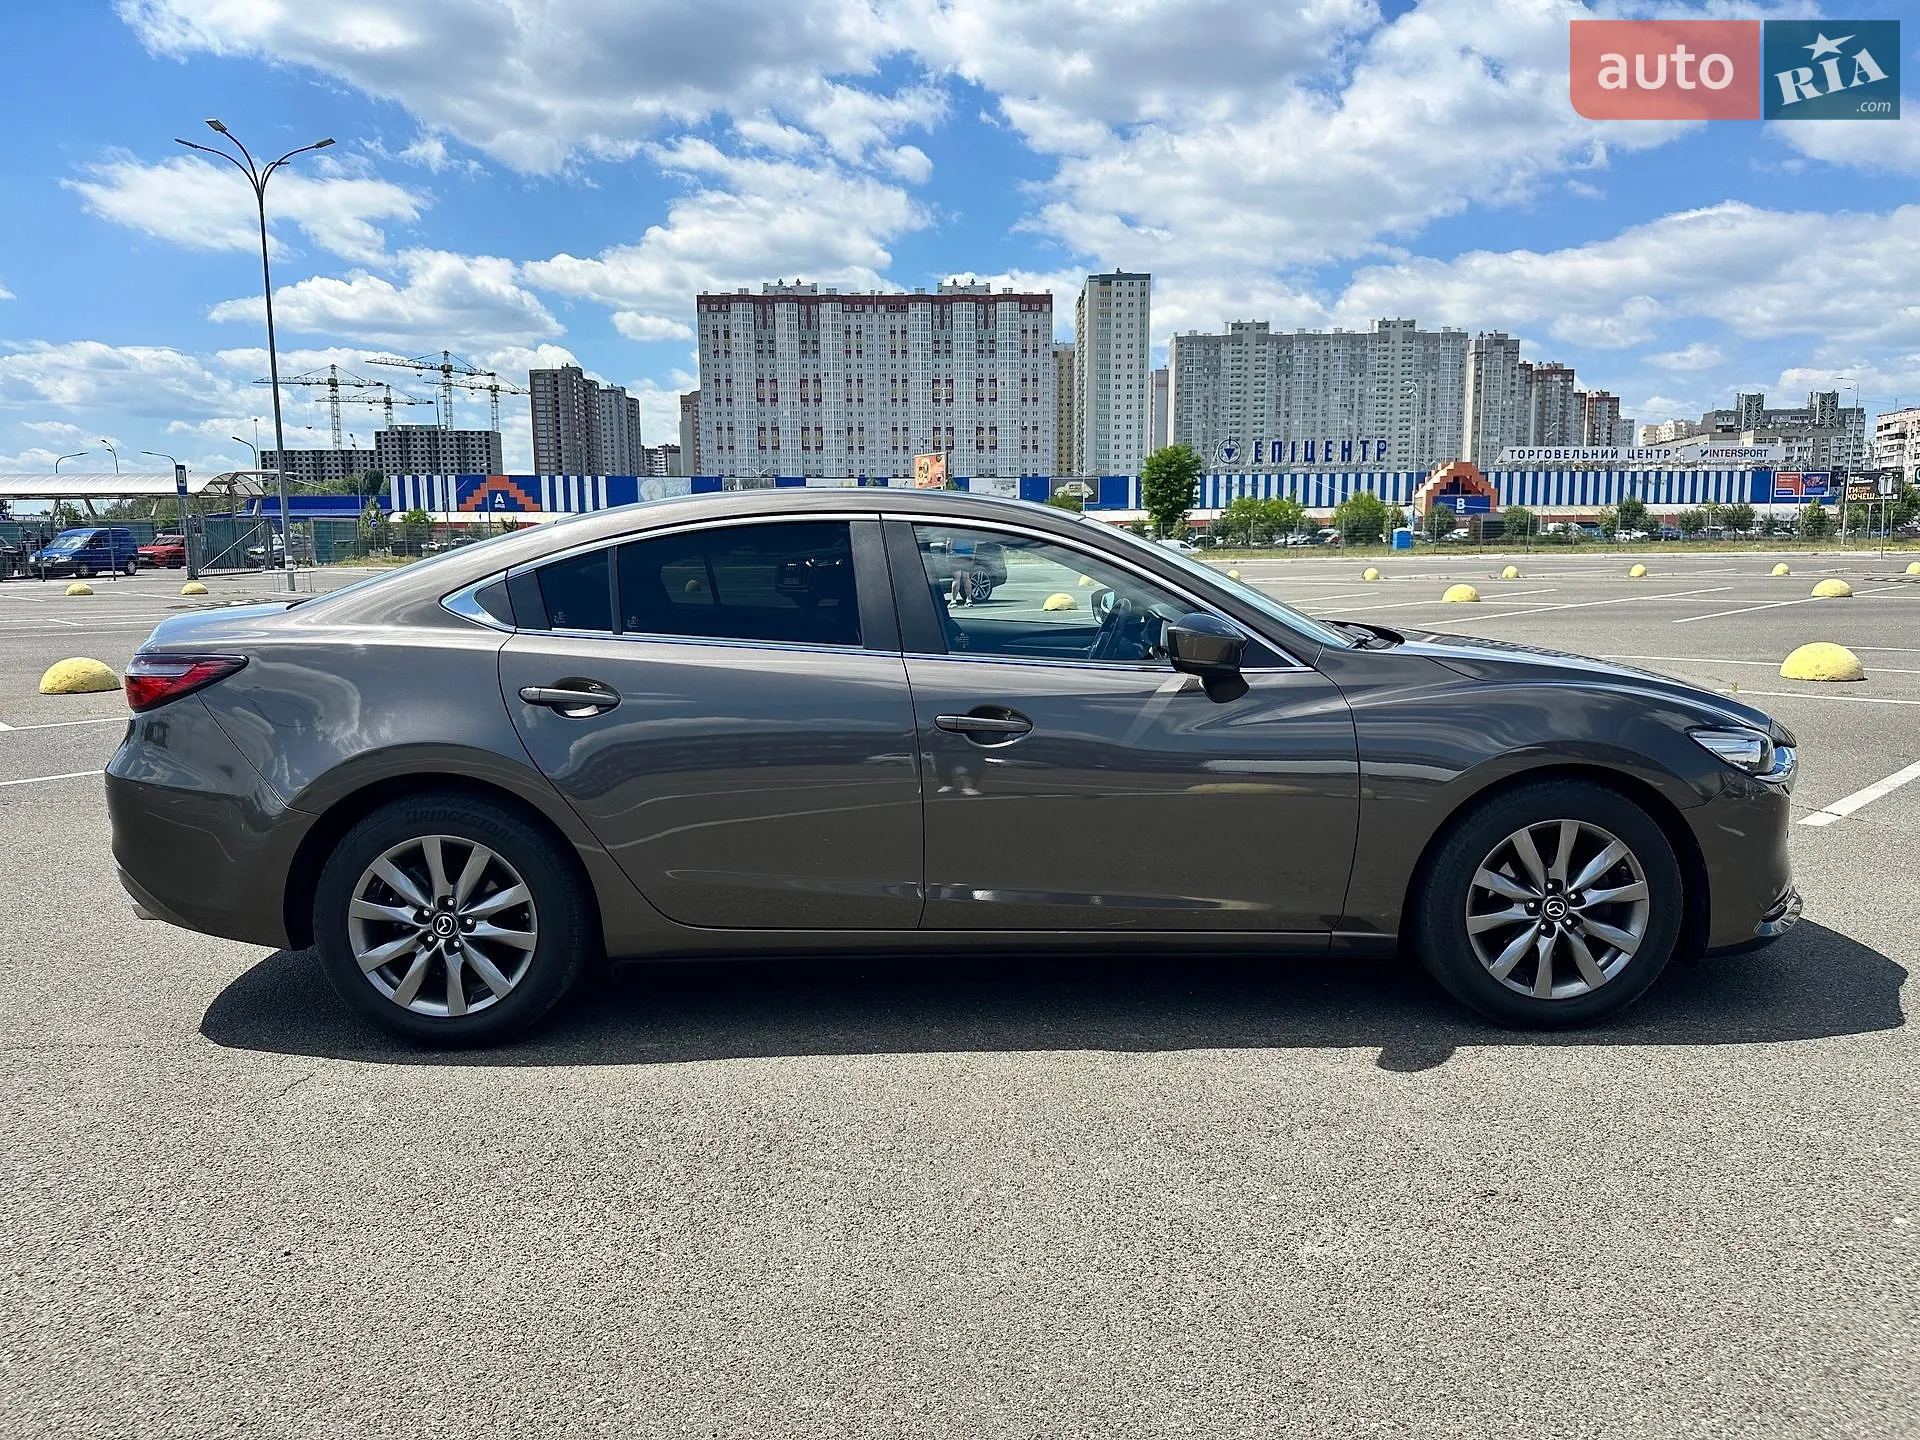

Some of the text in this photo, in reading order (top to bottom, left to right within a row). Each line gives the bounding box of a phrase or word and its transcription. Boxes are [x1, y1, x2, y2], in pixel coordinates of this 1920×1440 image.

[1253, 440, 1387, 464] ЕПІЦЕНТР
[1509, 446, 1671, 460] ТОРГОВЕЛЬНИЙ ЦЕНТР
[1708, 448, 1769, 458] INTERSPORT
